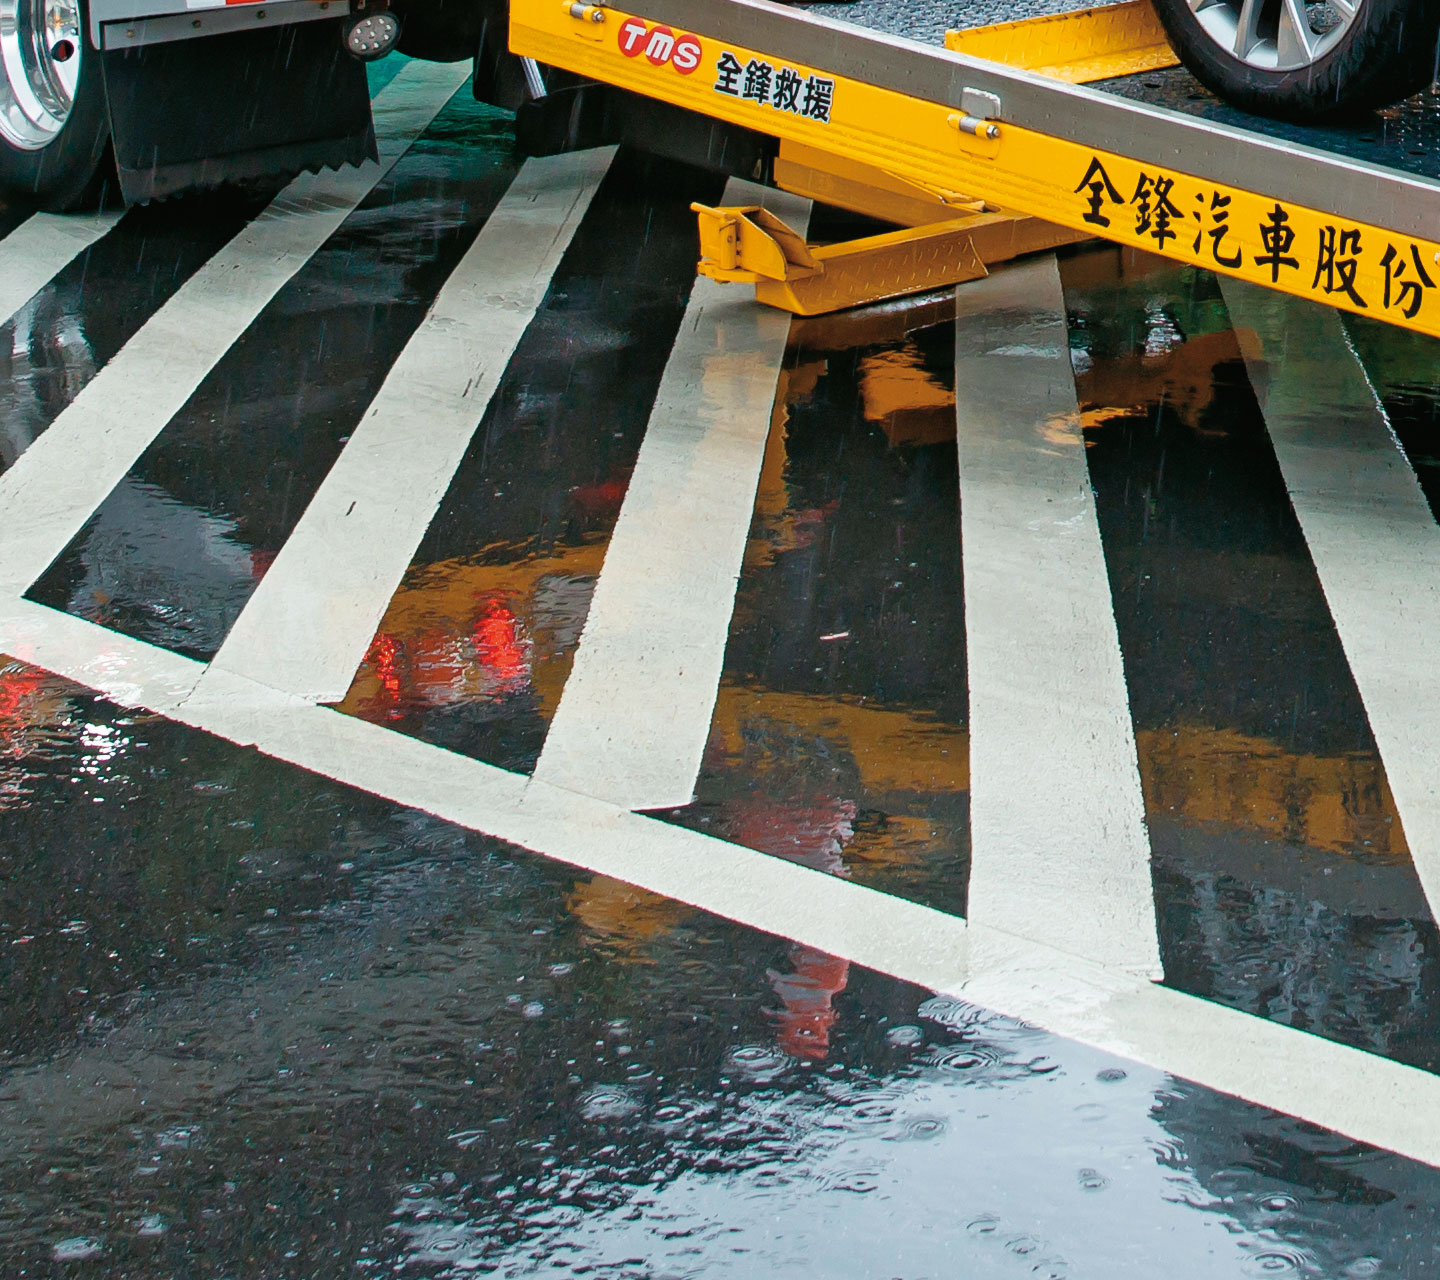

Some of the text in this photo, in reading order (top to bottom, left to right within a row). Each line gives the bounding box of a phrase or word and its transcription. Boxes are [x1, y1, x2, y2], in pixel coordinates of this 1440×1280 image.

[621, 20, 702, 72] TMS
[713, 51, 835, 124] 全鋒救援
[1073, 155, 1437, 320] 全鋒汽車股份
